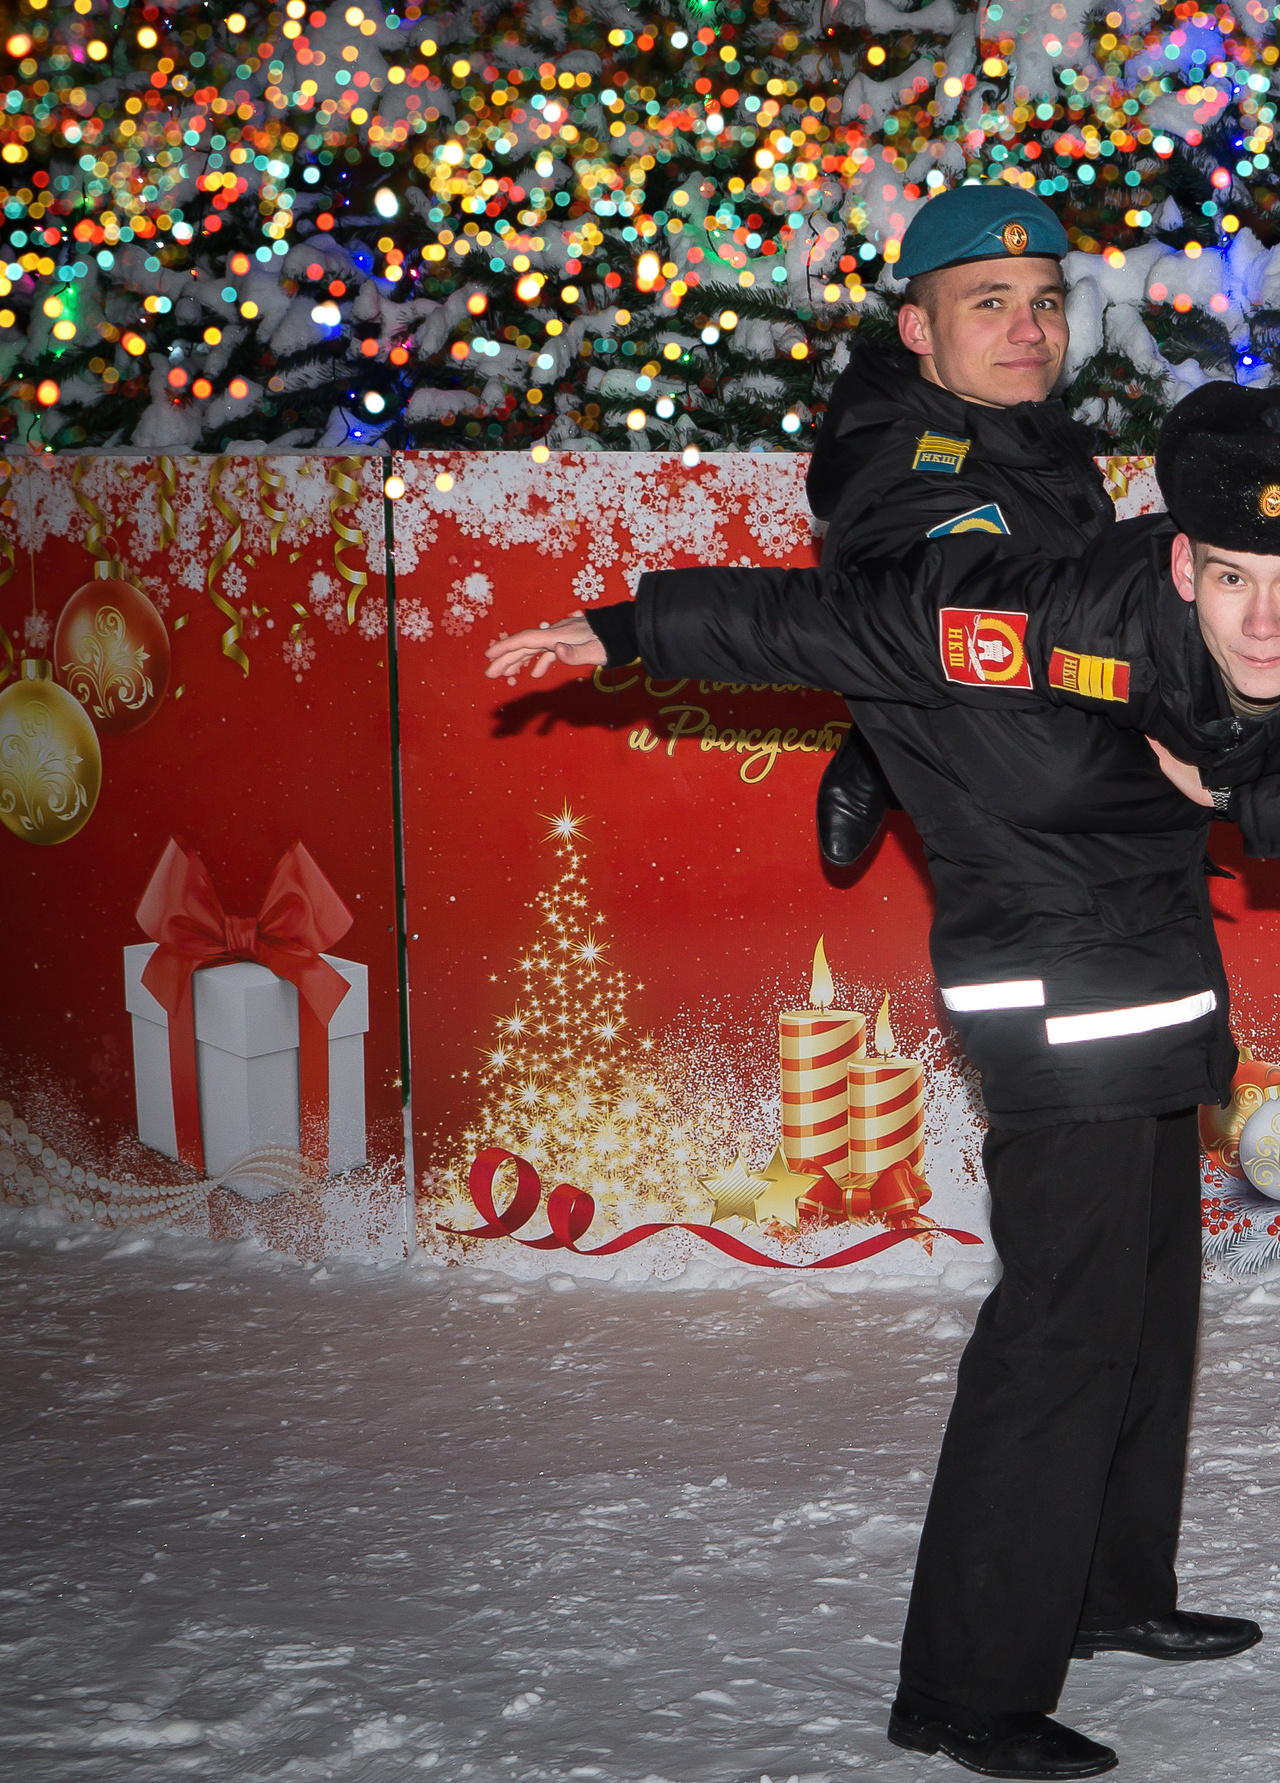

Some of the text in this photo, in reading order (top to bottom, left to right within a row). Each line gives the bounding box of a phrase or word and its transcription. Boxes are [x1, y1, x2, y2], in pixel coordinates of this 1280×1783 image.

[920, 453, 957, 465] НКШ
[947, 627, 965, 668] НКШ
[1061, 656, 1079, 691] НКШ
[627, 704, 852, 784] и Рождест
